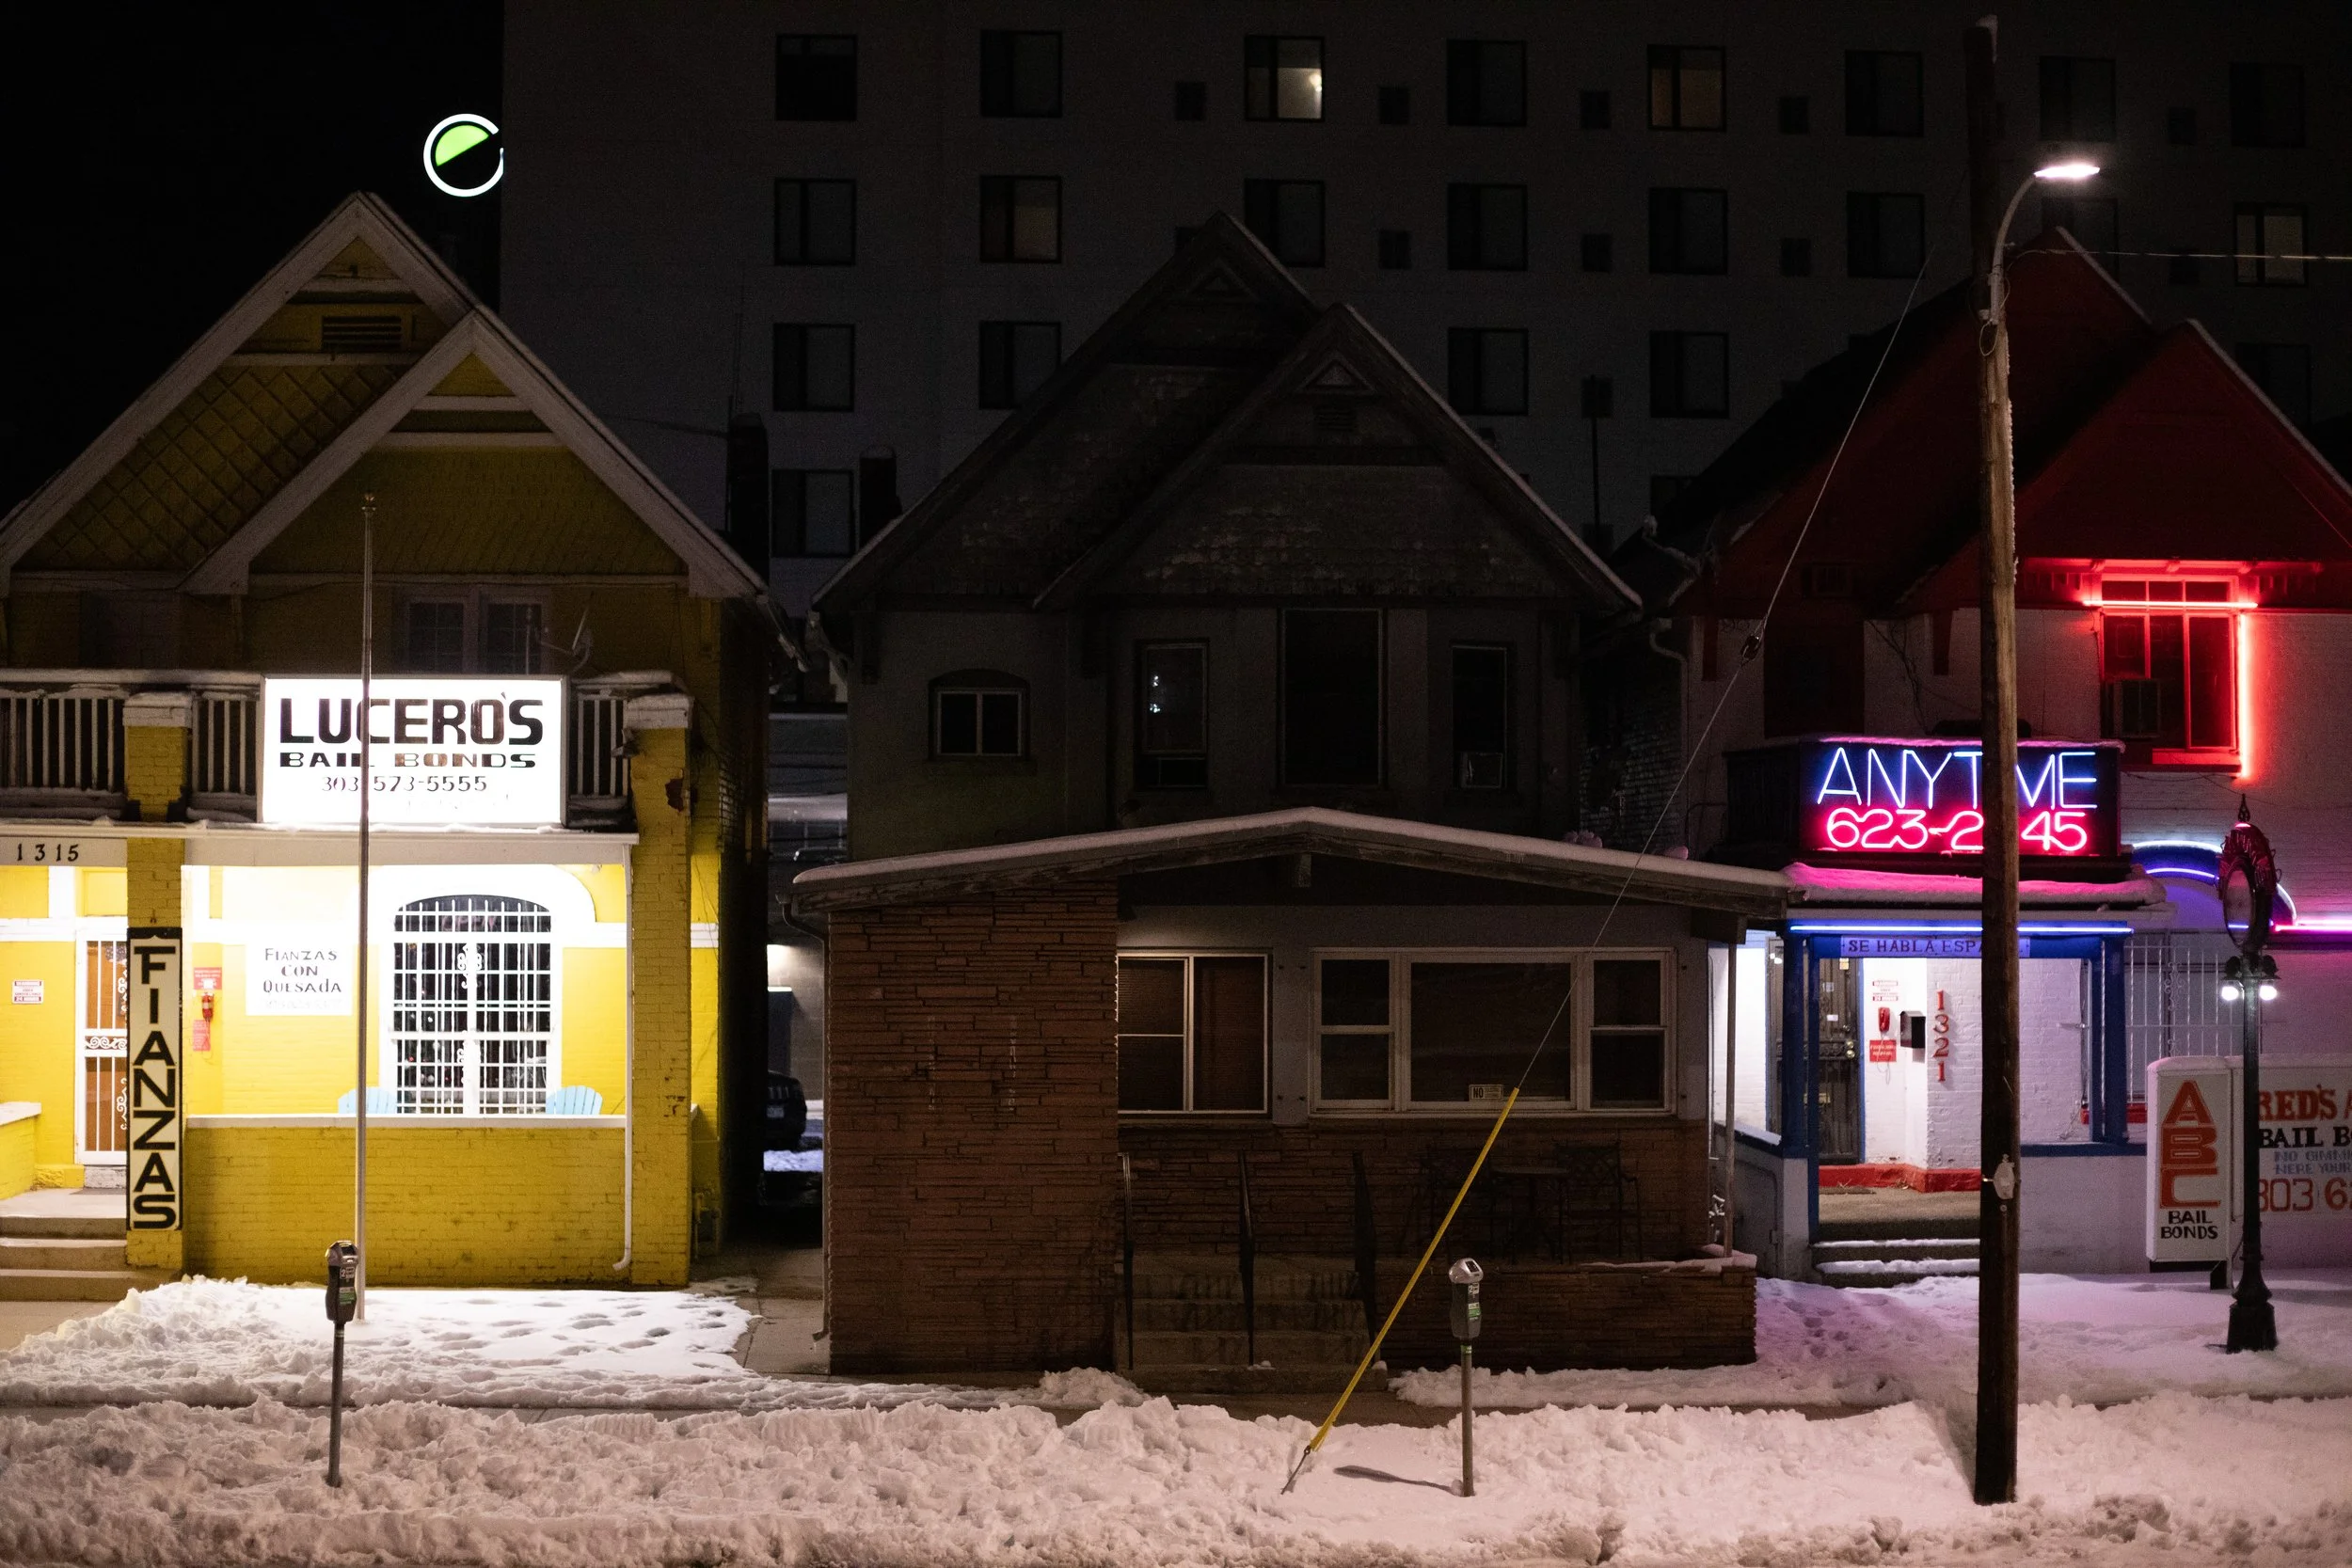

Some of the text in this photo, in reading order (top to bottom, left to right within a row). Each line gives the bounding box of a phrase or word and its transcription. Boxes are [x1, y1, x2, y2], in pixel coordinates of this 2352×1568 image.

[280, 691, 544, 746] LUCERO'S
[395, 752, 536, 768] BONDS
[1817, 747, 2098, 810] ANYTME
[1826, 807, 2088, 851] 623-245
[264, 948, 338, 961] FIANZAS
[1849, 940, 1869, 953] SE
[1877, 940, 1935, 953] HABLA
[280, 964, 318, 977] CON
[133, 945, 177, 1230] FIANZAS
[2159, 1079, 2221, 1210] ABC
[2259, 1127, 2324, 1148] BAIL
[2169, 1211, 2213, 1224] BAIL
[2160, 1226, 2218, 1240] BONDS
